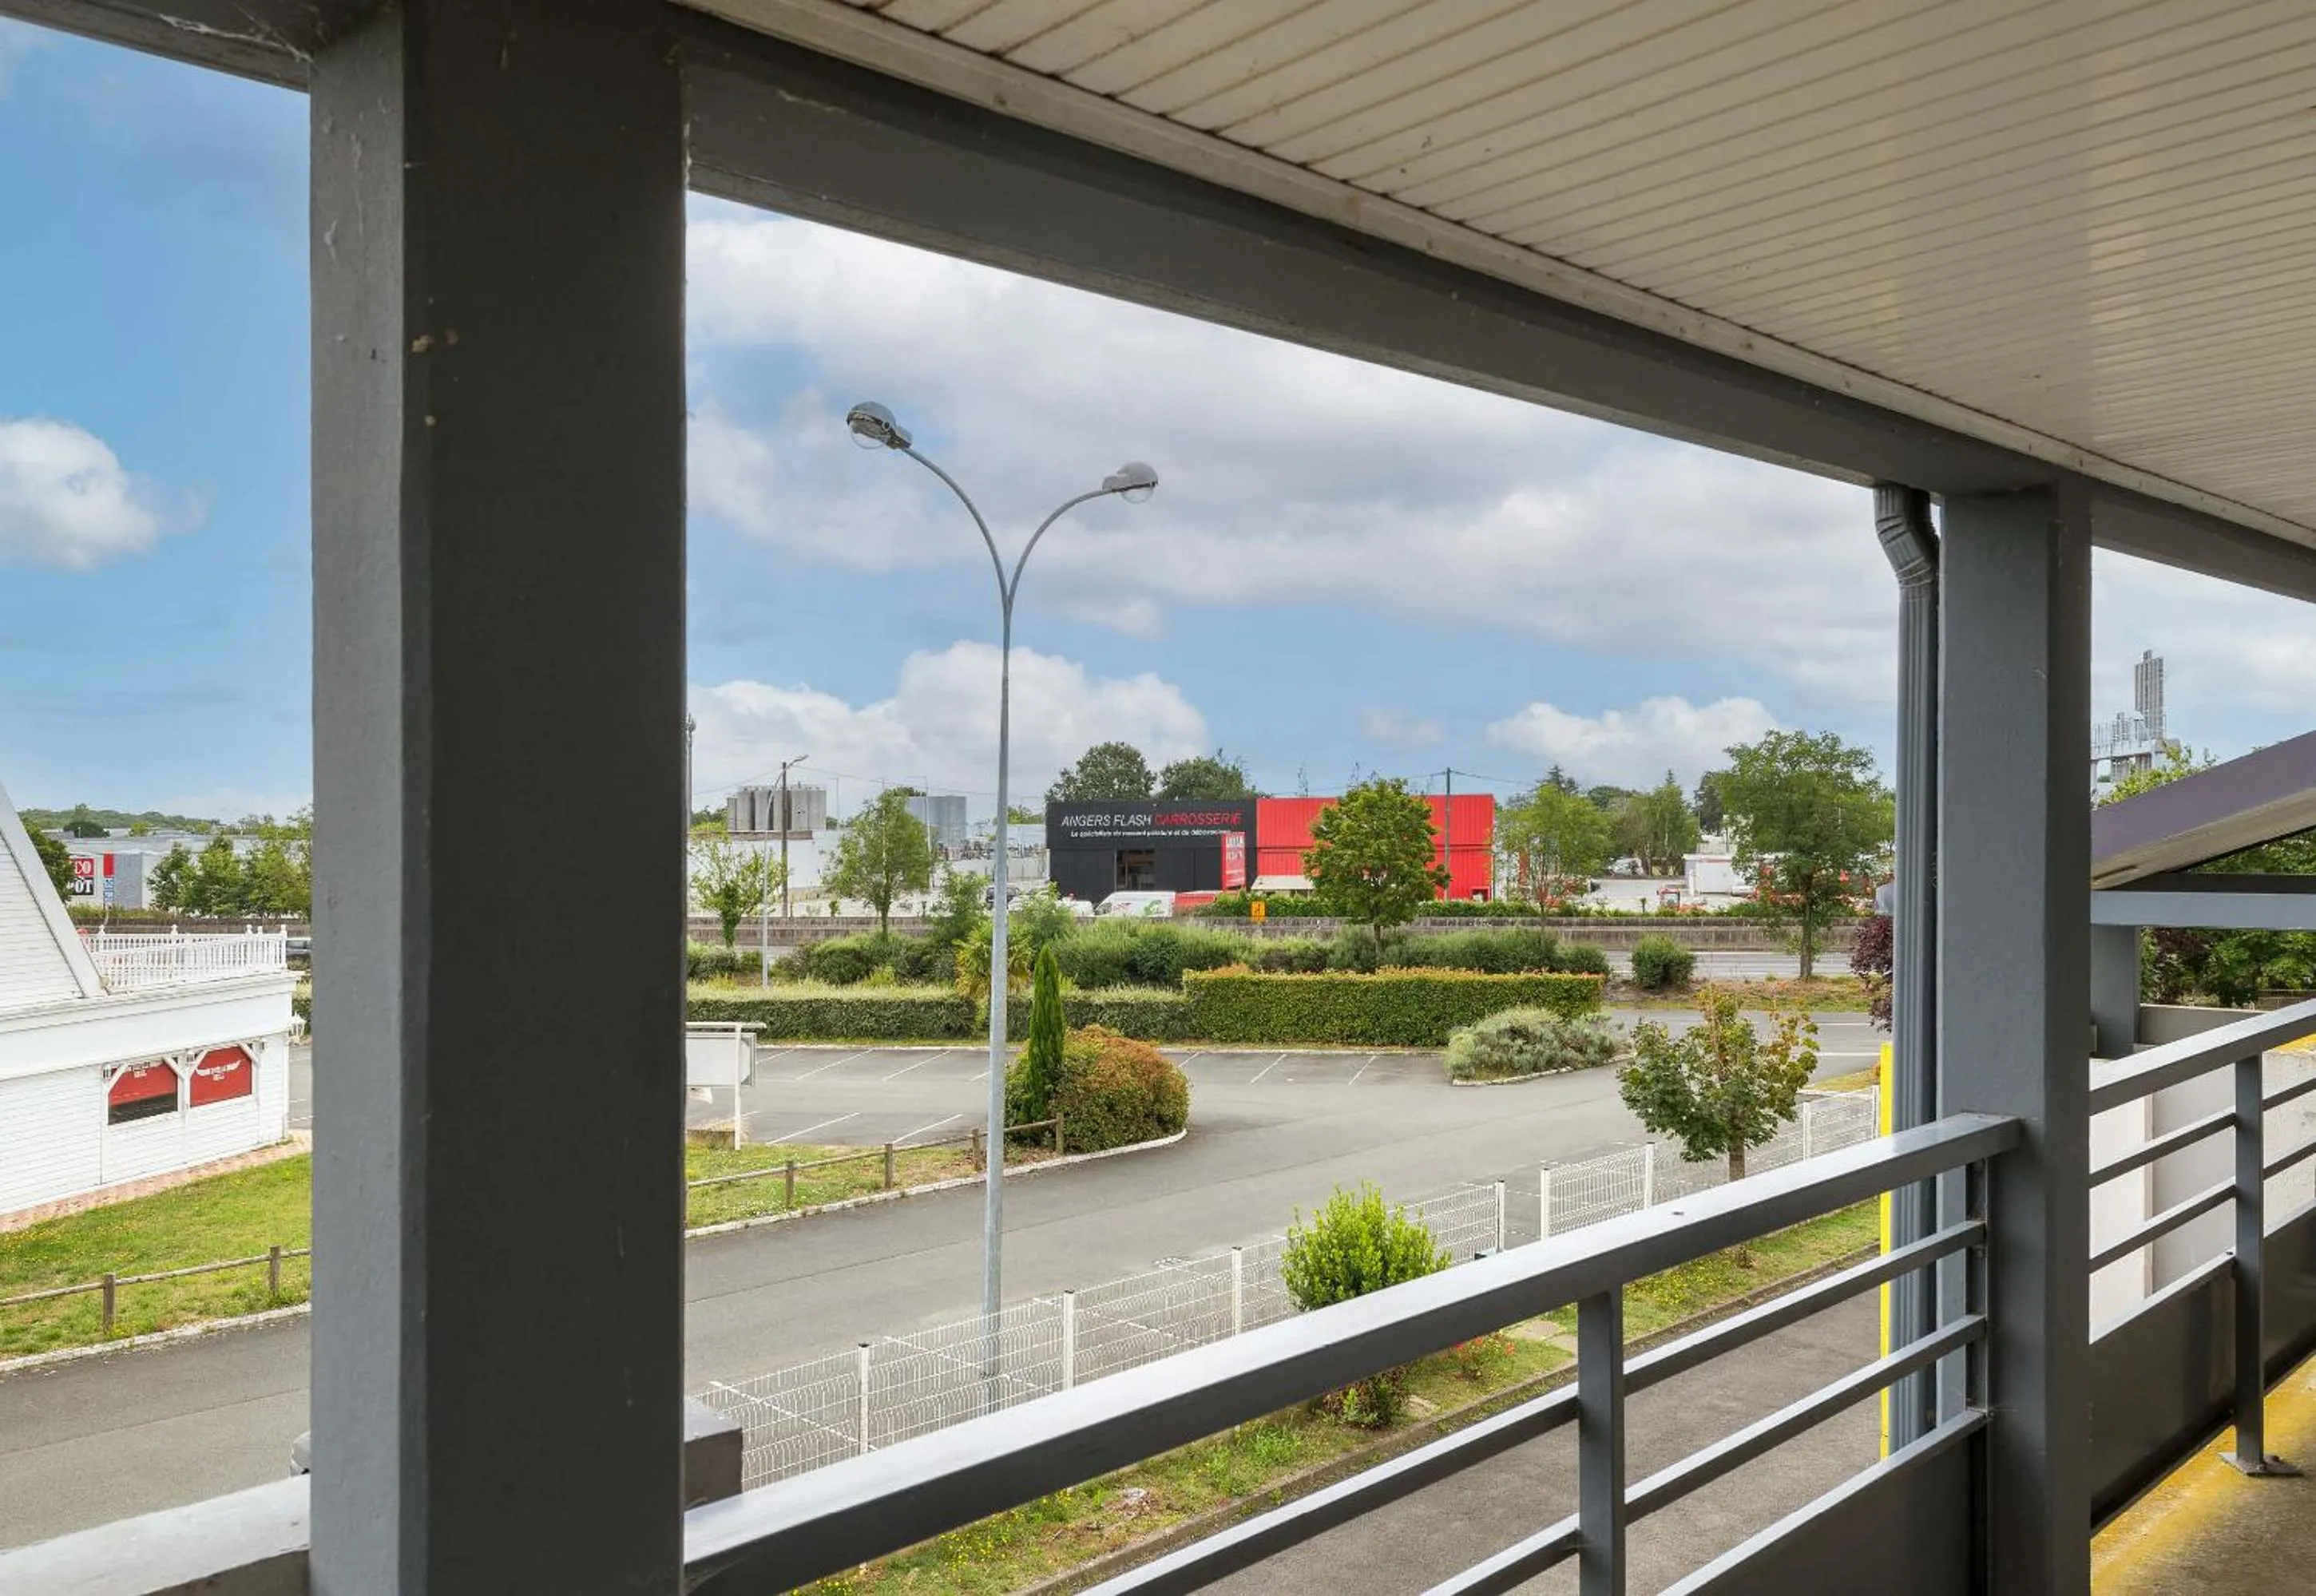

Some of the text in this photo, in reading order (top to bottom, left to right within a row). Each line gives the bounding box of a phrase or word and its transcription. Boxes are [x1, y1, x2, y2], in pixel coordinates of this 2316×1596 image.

[1061, 812, 1243, 827] ANGERS FLASH CARROSSERIE
